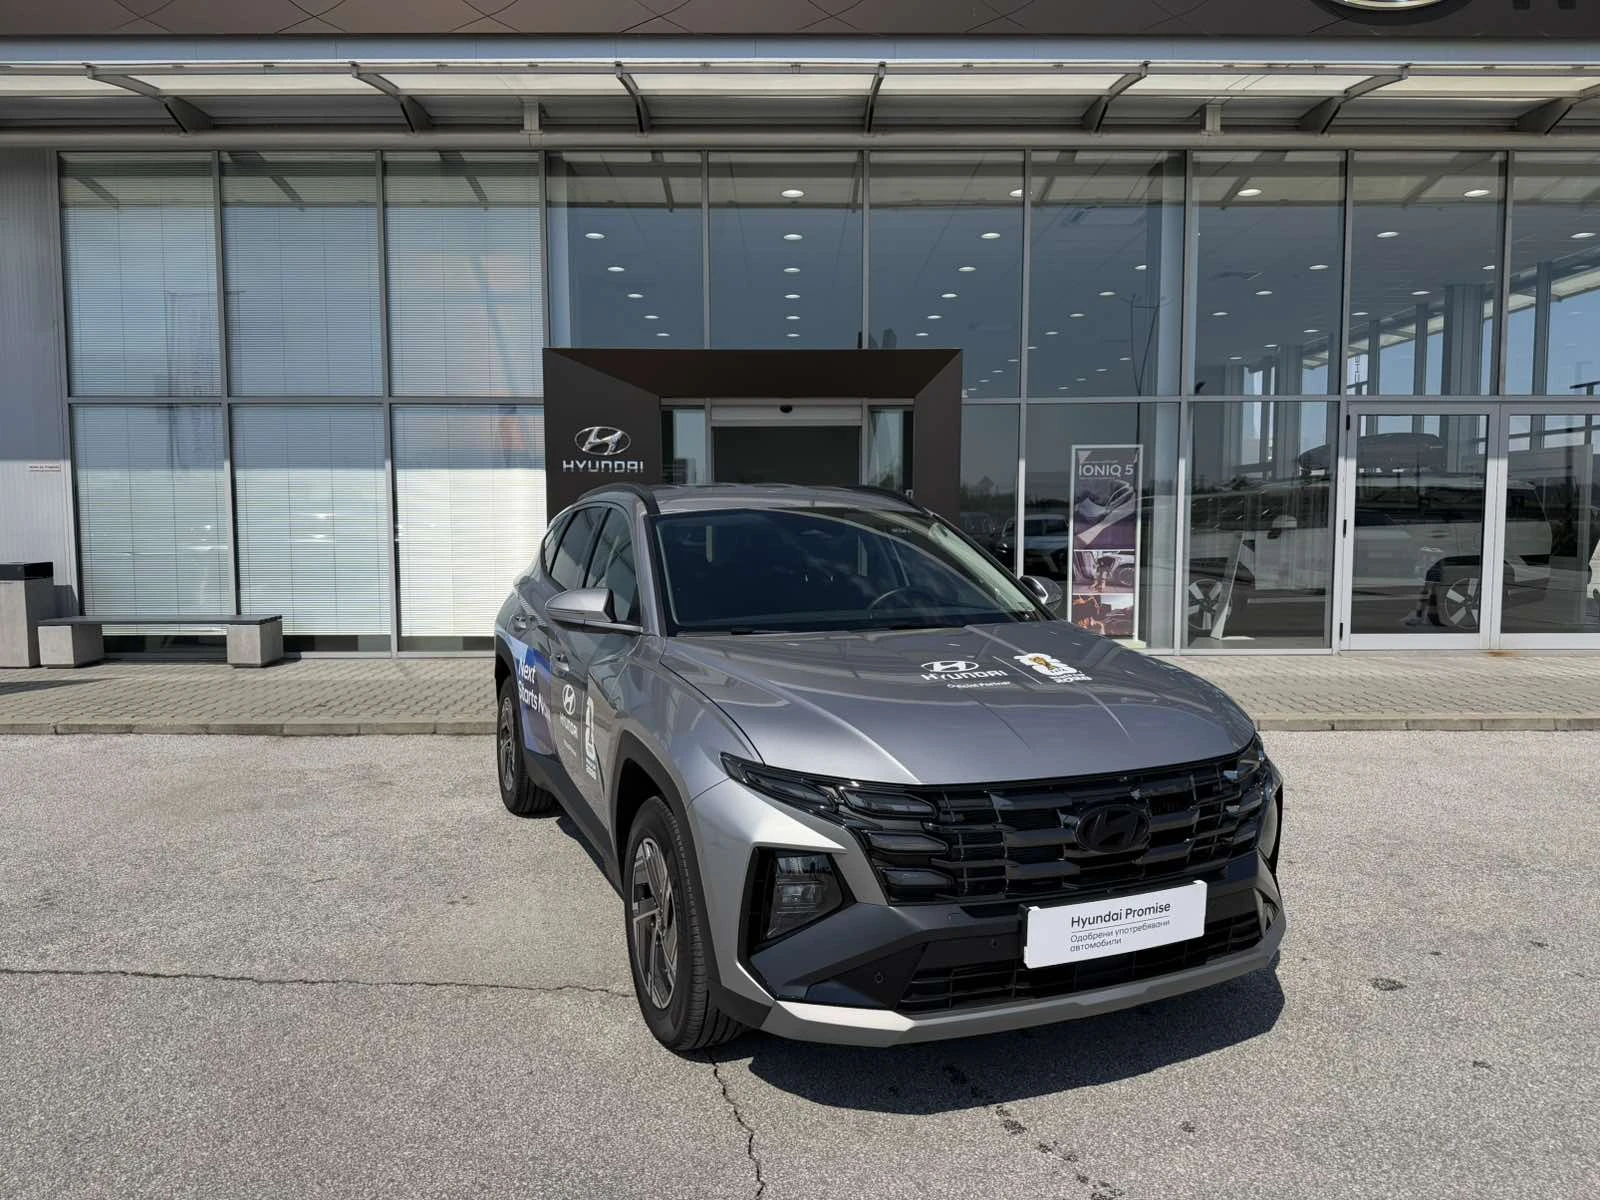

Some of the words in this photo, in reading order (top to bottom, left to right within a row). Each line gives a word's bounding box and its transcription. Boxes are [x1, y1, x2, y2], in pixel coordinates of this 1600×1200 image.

[562, 460, 644, 472] HYUNDAI
[1078, 464, 1121, 477] IONIQ
[1124, 464, 1134, 475] 5
[518, 658, 536, 684] Next
[921, 670, 1009, 681] HYUNDAI
[518, 680, 538, 710] Starts
[1071, 909, 1122, 928] Hyundai
[1125, 902, 1171, 919] Promise
[1070, 931, 1113, 943] Одобрени
[1115, 920, 1170, 937] употребявани
[1070, 938, 1121, 952] автомобили
